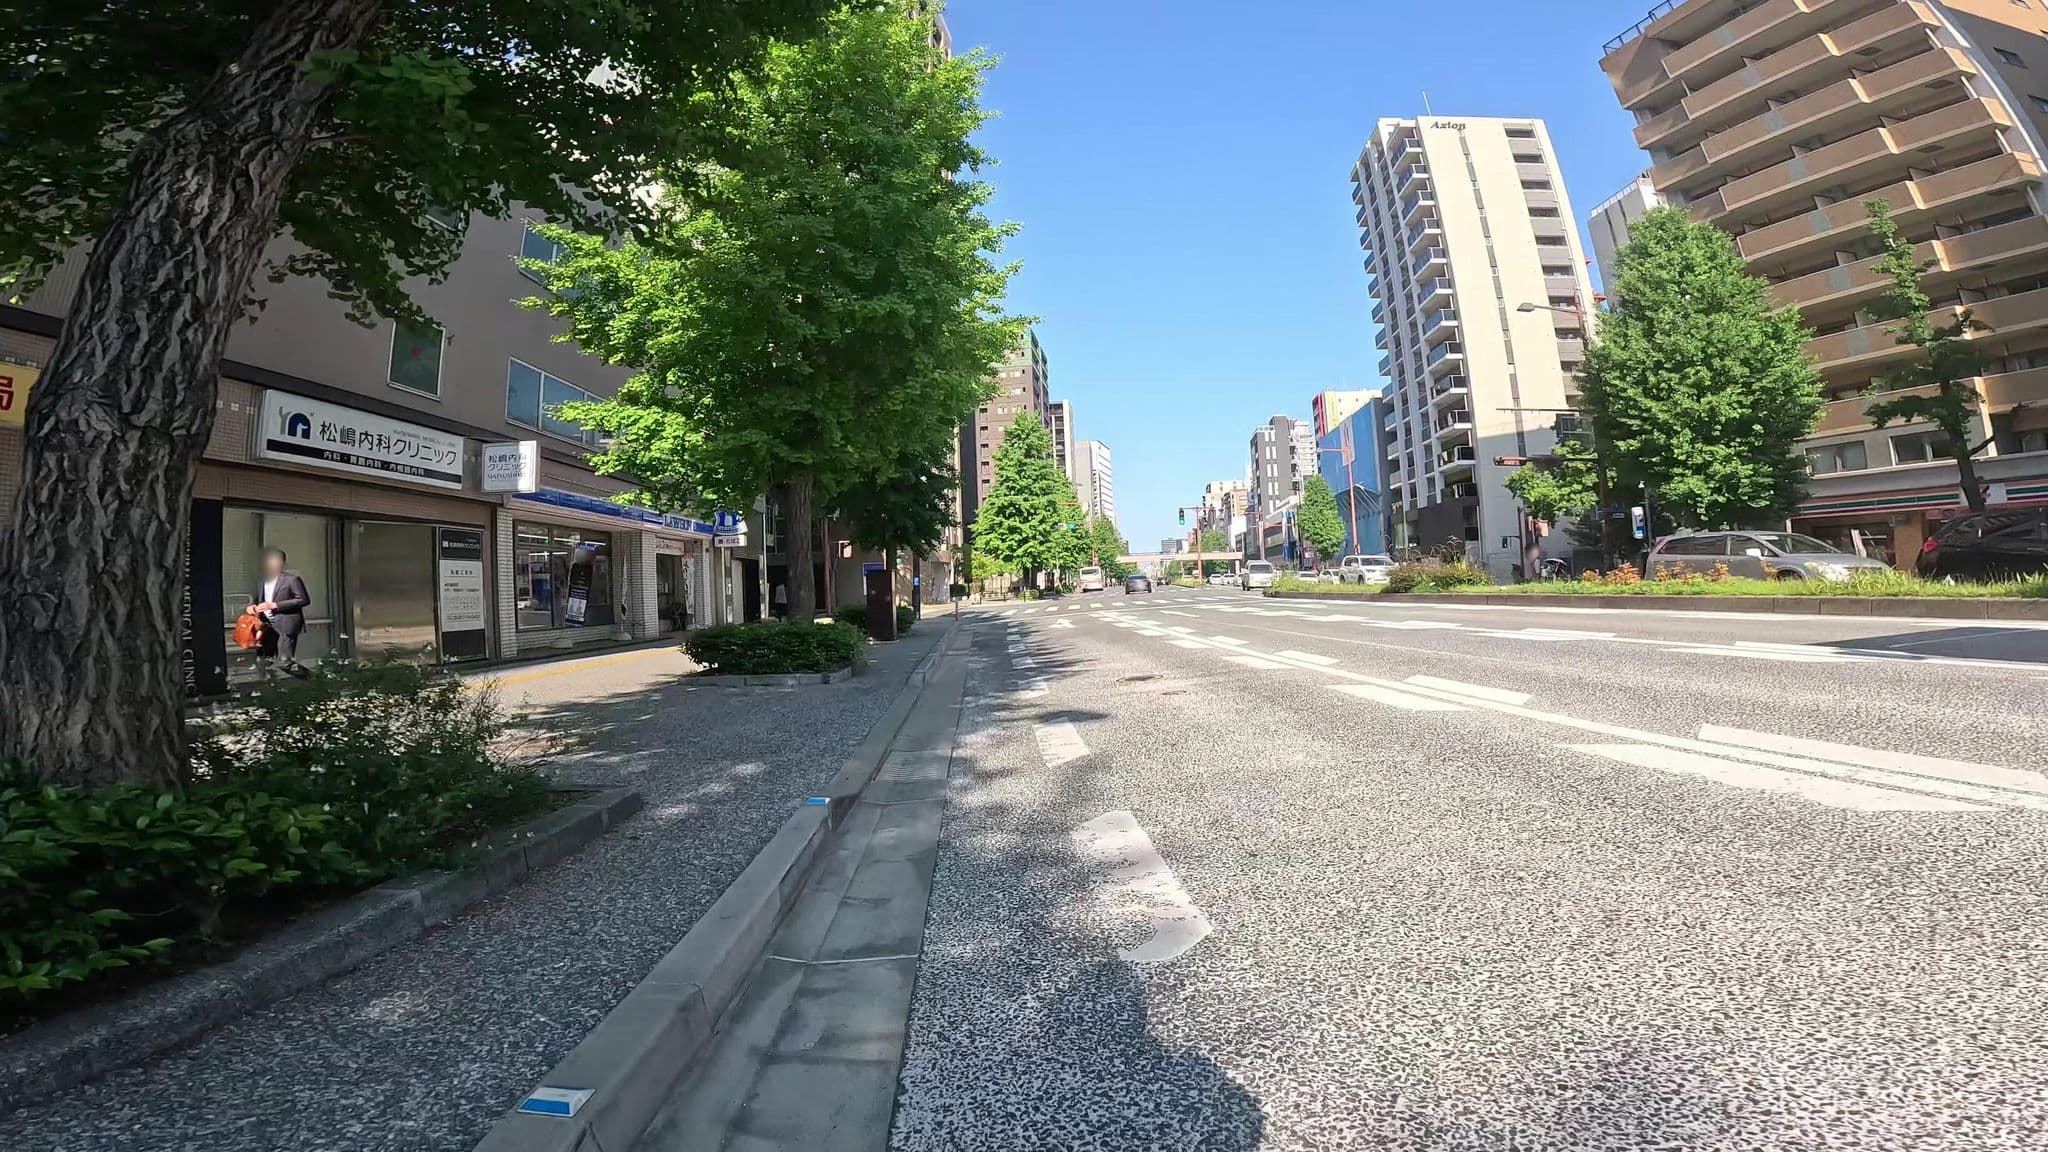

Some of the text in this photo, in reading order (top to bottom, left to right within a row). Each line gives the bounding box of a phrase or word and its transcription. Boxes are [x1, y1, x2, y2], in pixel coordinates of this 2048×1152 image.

[1431, 121, 1466, 130] Axion
[319, 421, 457, 466] 松嶋内科クリニック
[488, 462, 527, 471] クリニック
